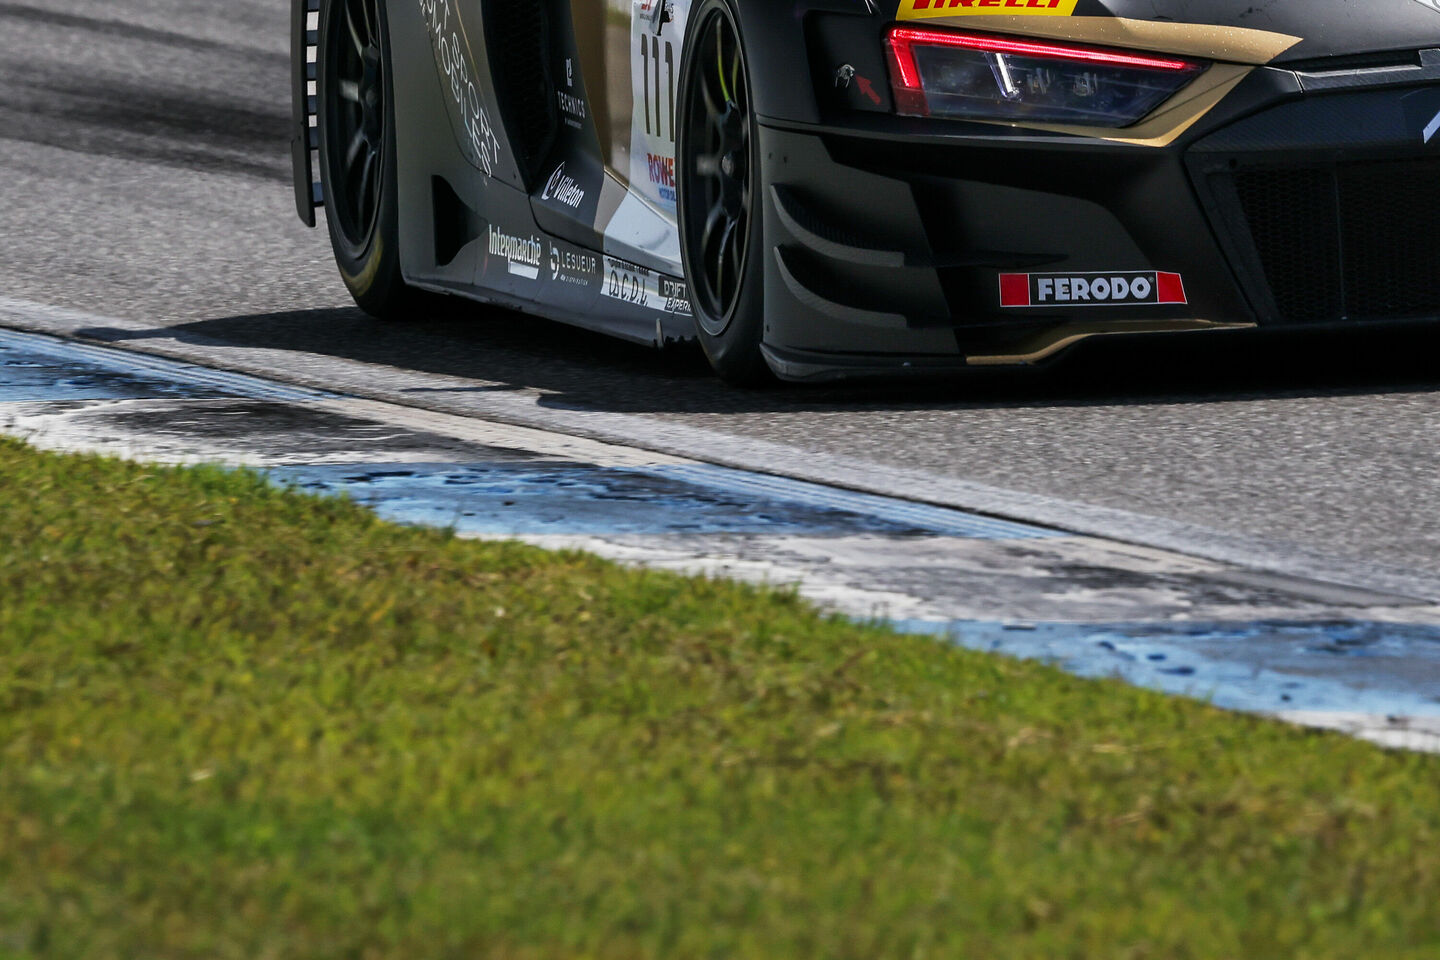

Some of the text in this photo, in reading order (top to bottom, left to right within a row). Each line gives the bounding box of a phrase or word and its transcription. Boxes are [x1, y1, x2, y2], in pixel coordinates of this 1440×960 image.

[451, 32, 500, 165] SPORT
[557, 90, 586, 119] TECHNICS
[641, 33, 675, 142] 111
[647, 153, 676, 187] ROWE
[488, 224, 541, 265] Intermarché
[561, 251, 596, 274] LESUEUR
[1038, 276, 1151, 301] FERODO
